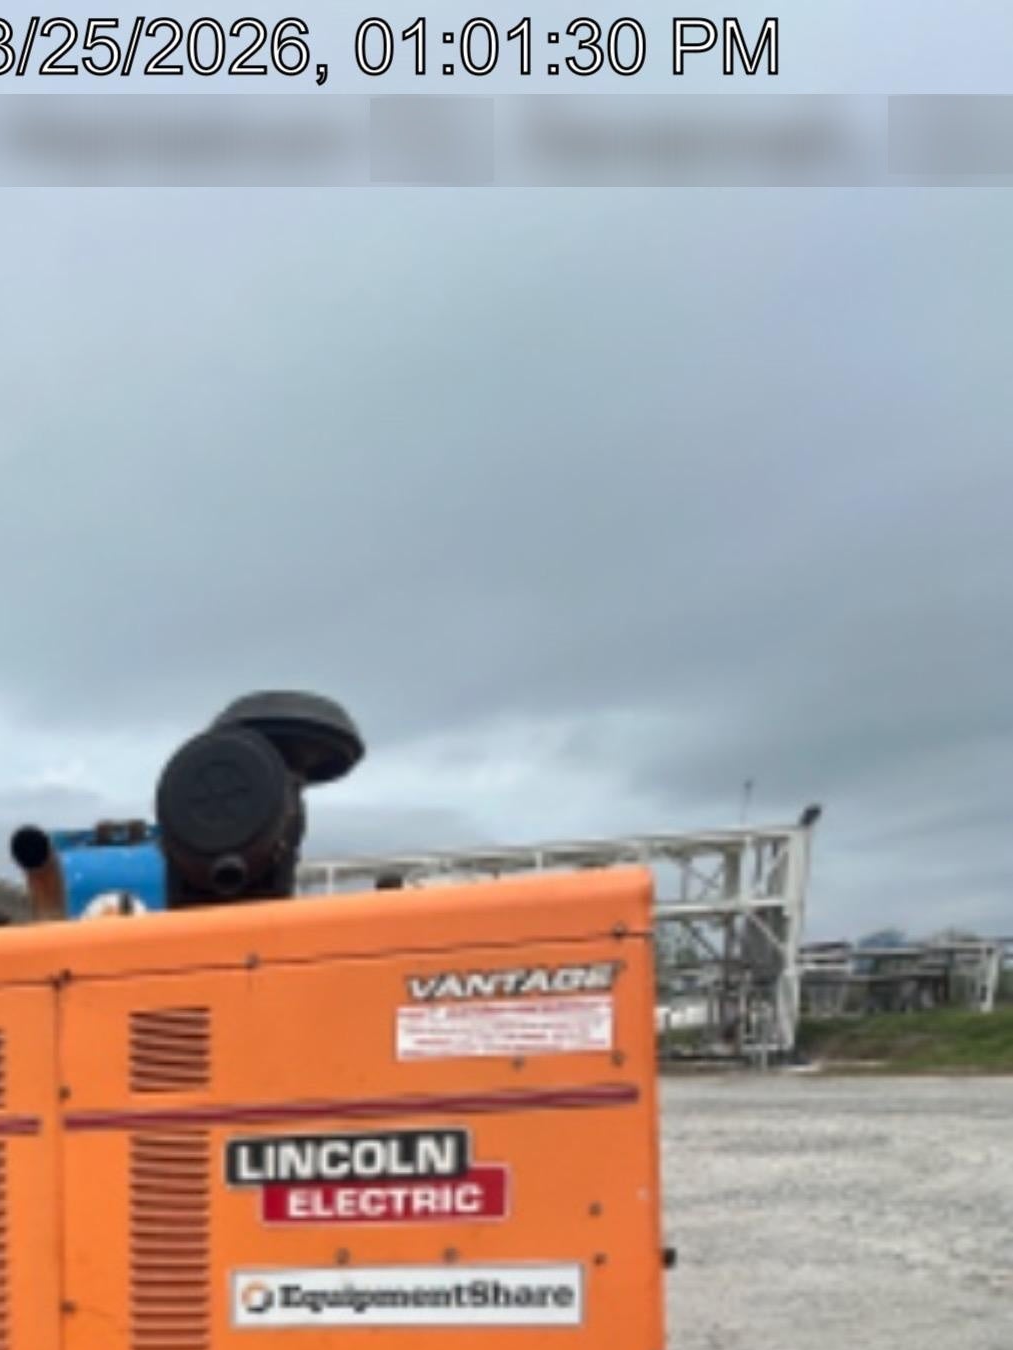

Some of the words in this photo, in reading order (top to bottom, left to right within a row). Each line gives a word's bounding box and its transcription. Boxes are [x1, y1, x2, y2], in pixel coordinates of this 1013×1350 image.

[406, 964, 620, 999] VANTAGE
[237, 1135, 457, 1181] LINCOLN
[287, 1183, 484, 1218] ELECTRIC
[278, 1281, 575, 1314] EquipmentShare
